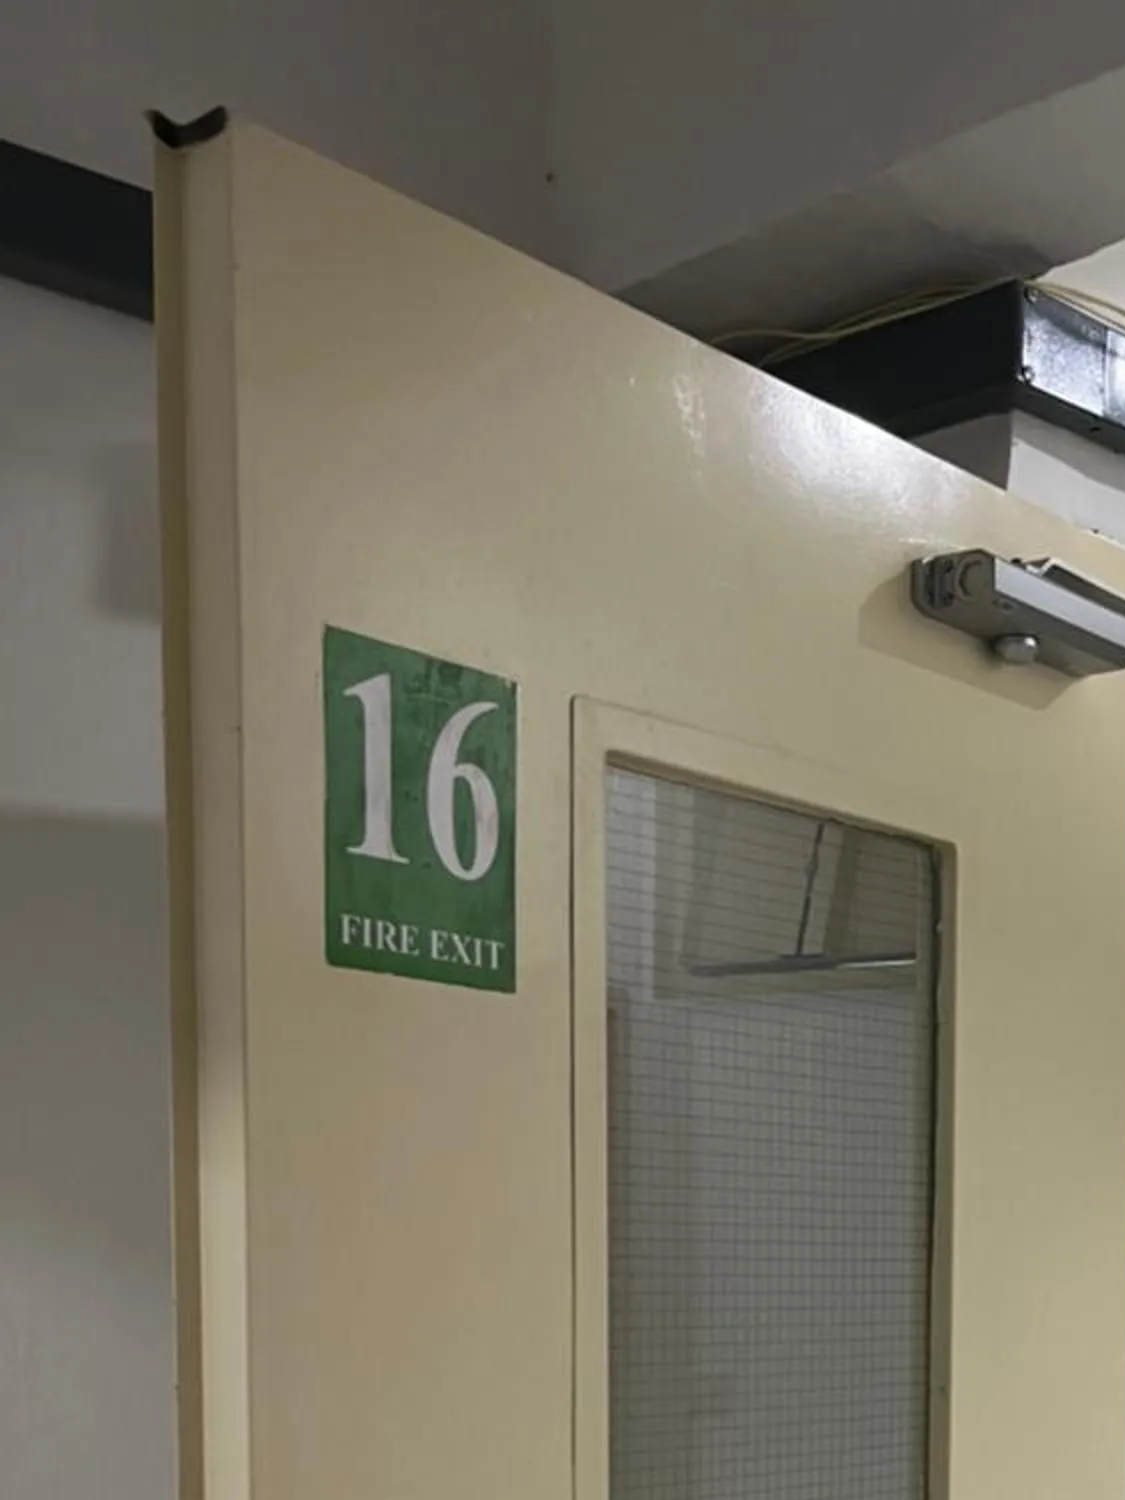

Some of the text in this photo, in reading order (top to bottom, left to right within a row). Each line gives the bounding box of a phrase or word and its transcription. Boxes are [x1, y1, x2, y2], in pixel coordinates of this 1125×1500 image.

[343, 673, 499, 881] 16
[341, 914, 504, 970] FIRE EXIT
